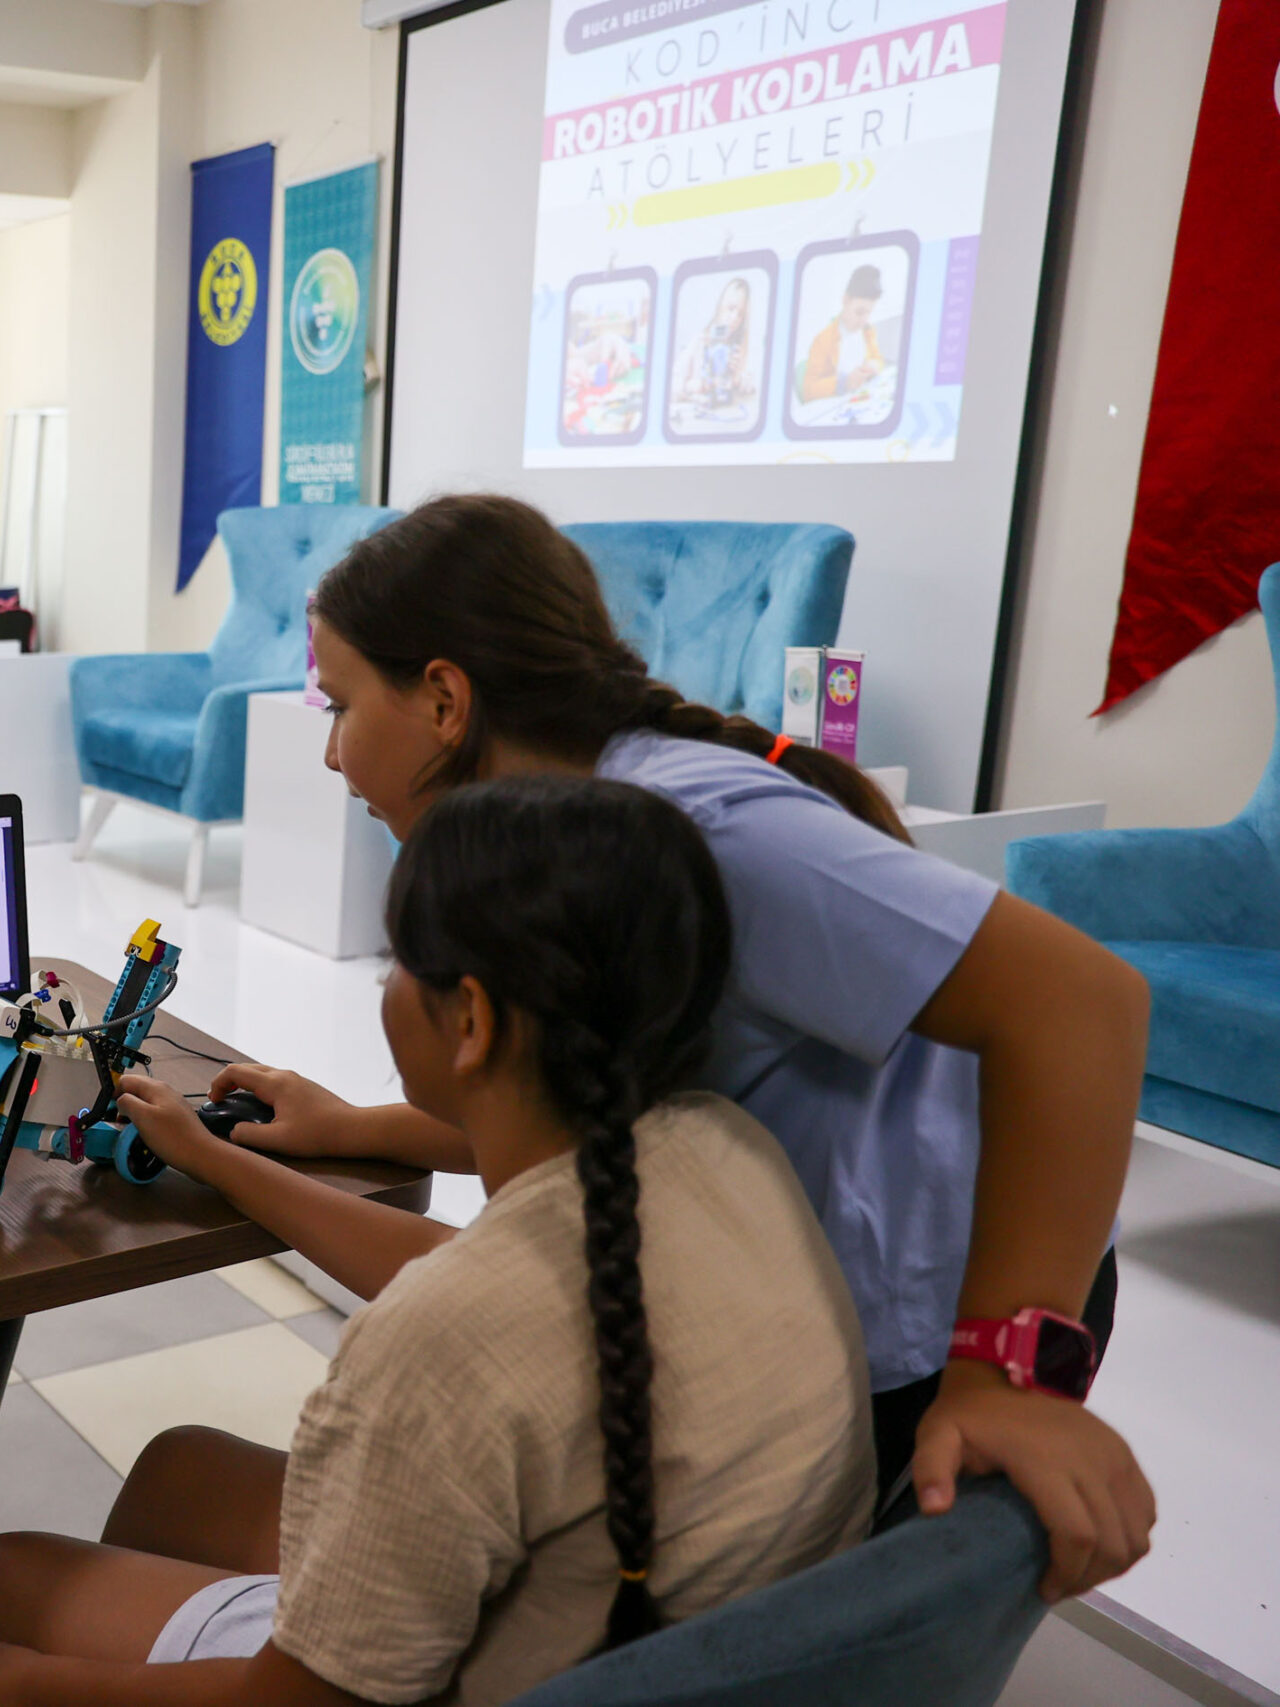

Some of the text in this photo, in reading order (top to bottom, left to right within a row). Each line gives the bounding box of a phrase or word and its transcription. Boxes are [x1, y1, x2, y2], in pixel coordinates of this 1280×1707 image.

[581, 16, 619, 40] BUCA
[553, 22, 972, 160] ROBOTİK KODLAMA
[586, 93, 917, 201] ATÖLYELERİ
